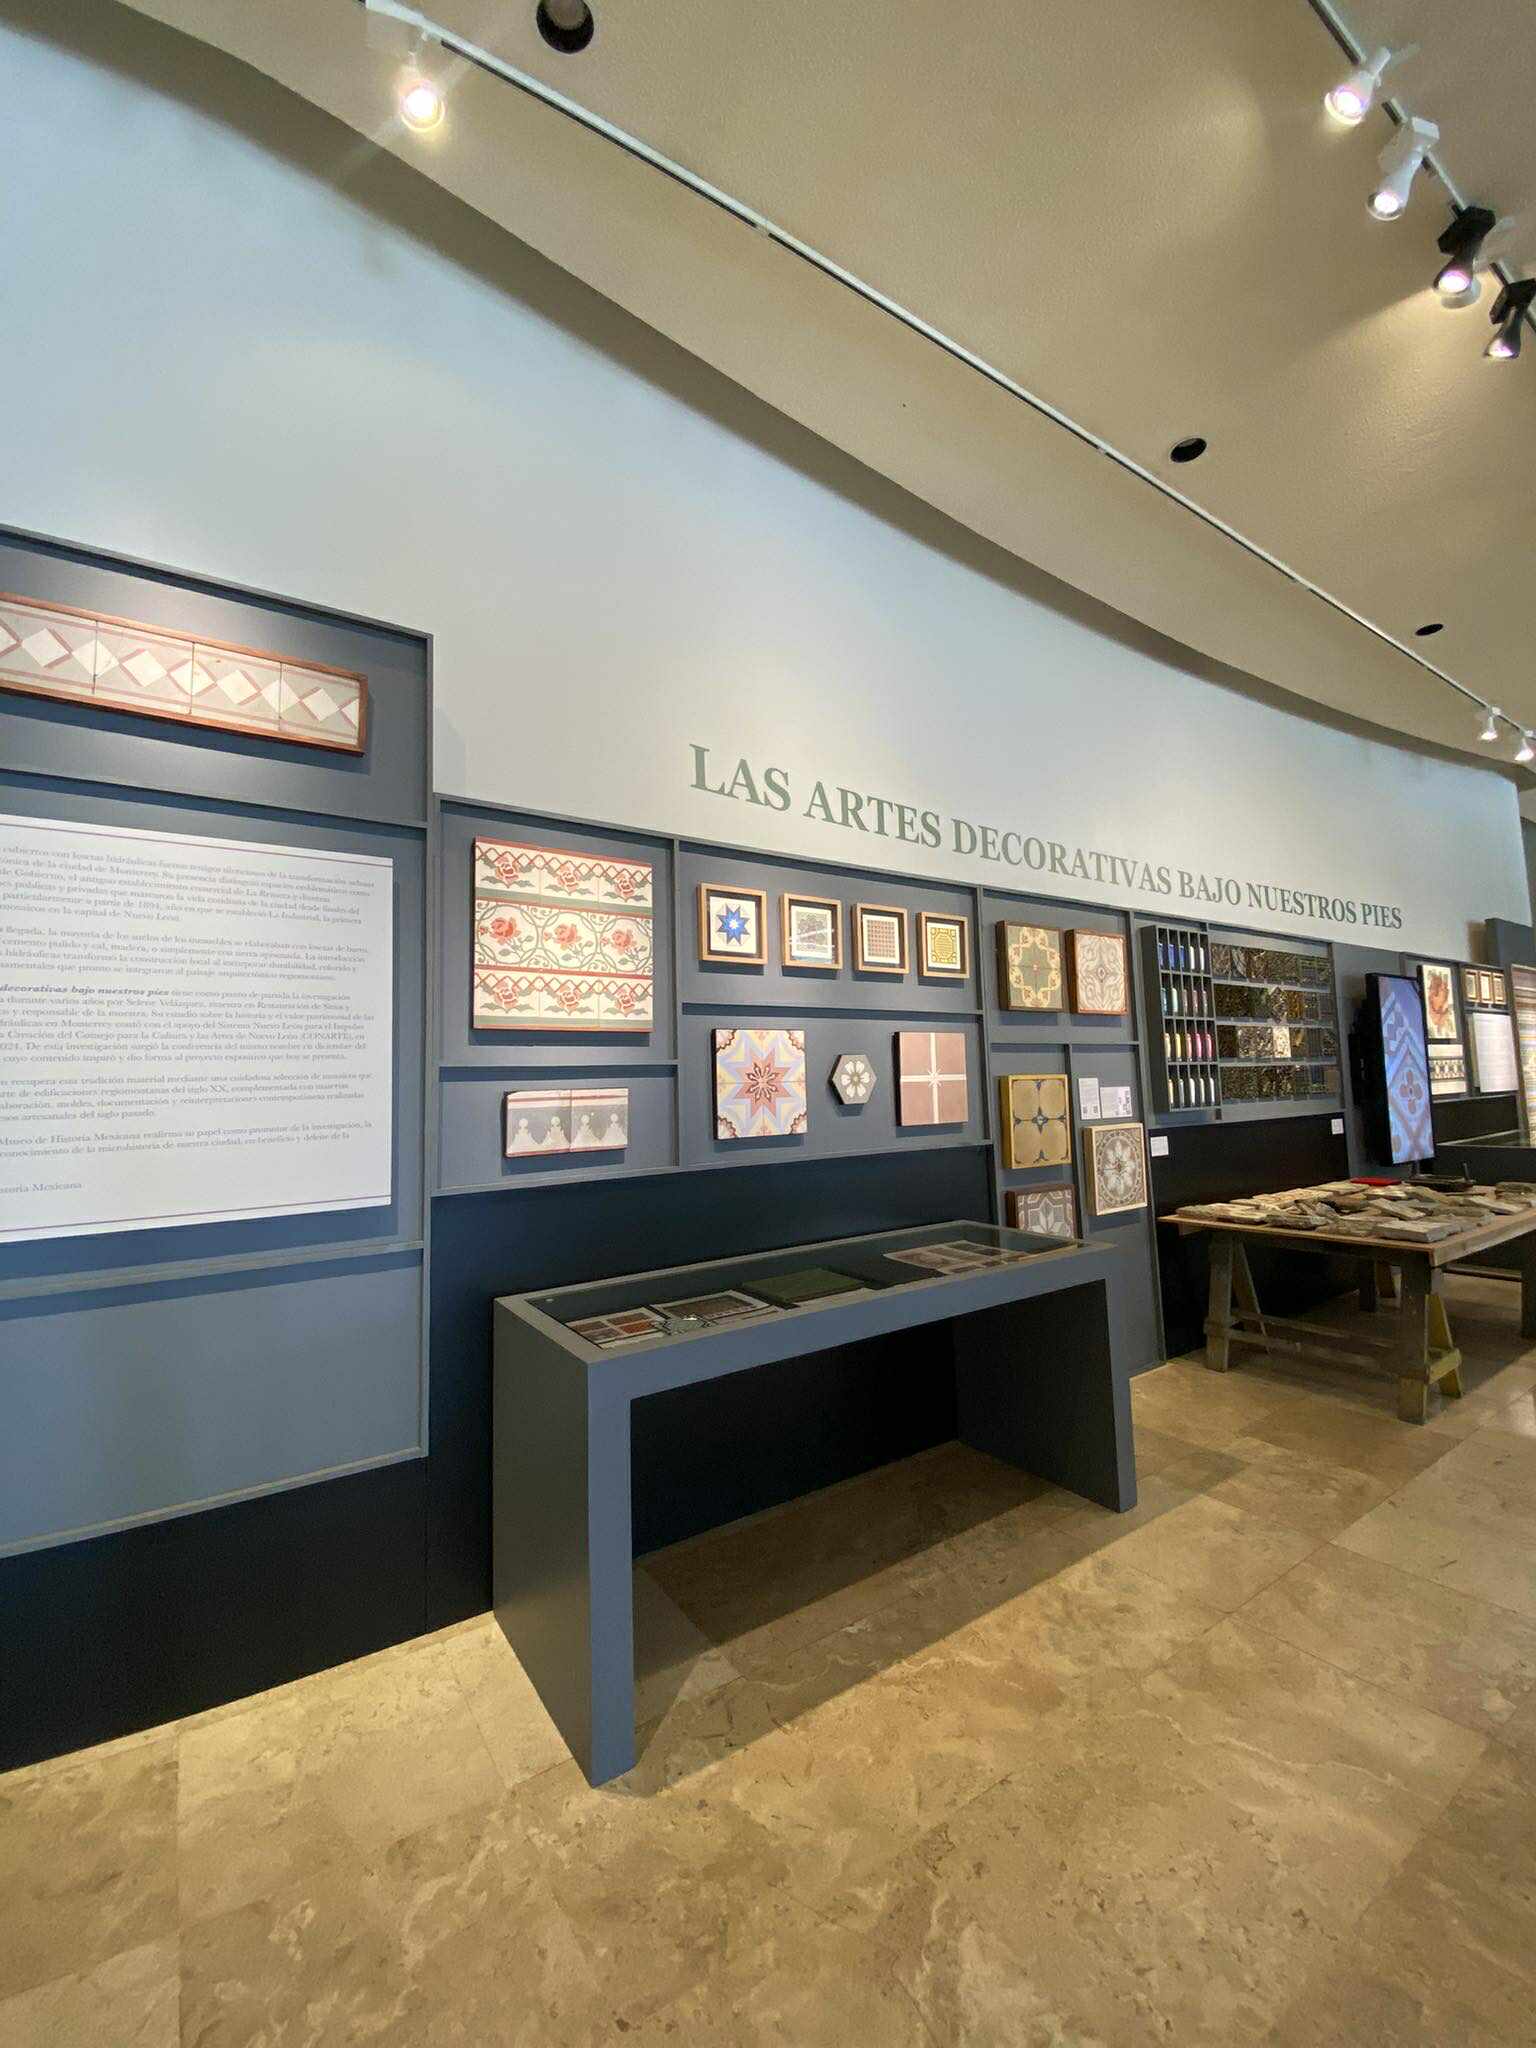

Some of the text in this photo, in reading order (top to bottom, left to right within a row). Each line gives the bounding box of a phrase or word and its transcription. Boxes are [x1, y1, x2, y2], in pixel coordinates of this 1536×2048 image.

[689, 744, 1403, 929] LAS ARTES DECORATIVAS BAJO NUESTROS PIES
[72, 986, 95, 996] bajo
[97, 987, 144, 995] nuestros
[147, 988, 168, 998] pies
